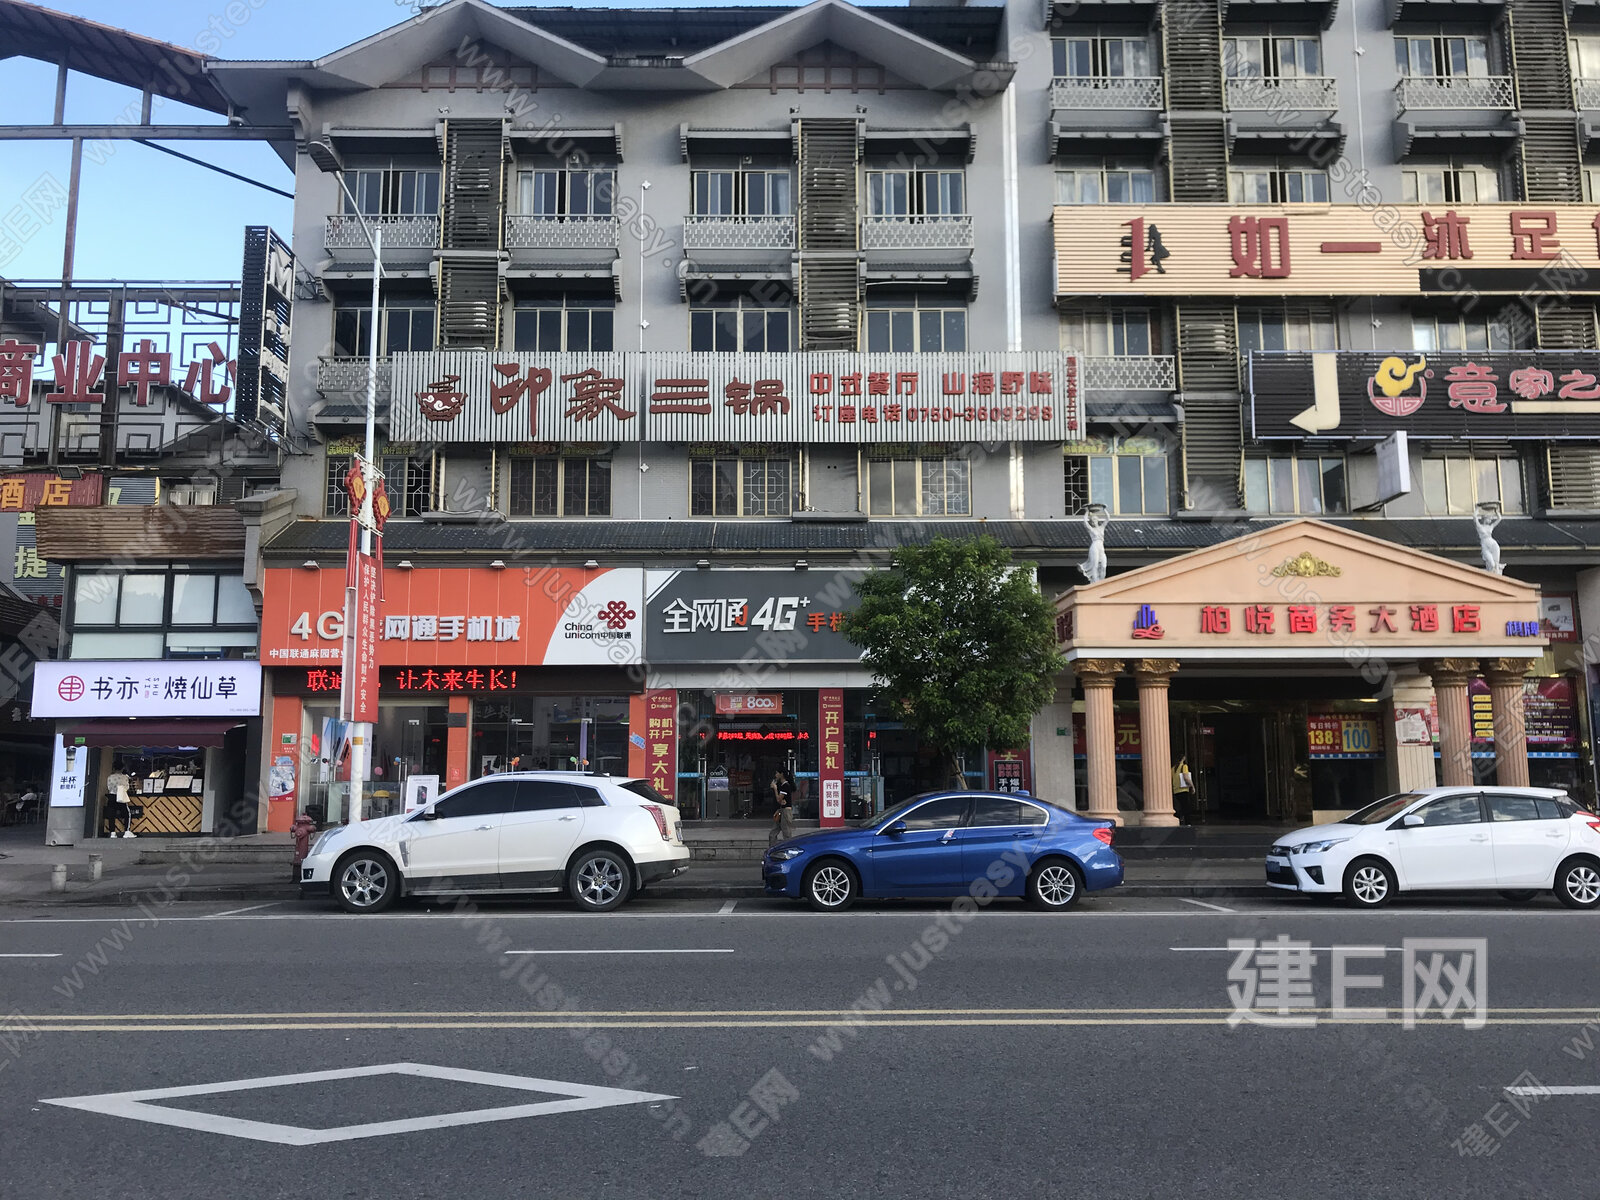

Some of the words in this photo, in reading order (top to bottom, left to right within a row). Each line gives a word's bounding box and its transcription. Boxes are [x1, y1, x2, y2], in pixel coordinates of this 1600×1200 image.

[1228, 210, 1600, 279] 如一沐足
[0, 338, 236, 408] 商业中心
[810, 372, 919, 395] 中式餐厅
[943, 371, 1052, 395] 山海野味
[490, 363, 790, 437] 印象三锅
[813, 403, 902, 424] 订座电话
[907, 405, 1053, 423] 0750-3609298
[565, 622, 593, 631] China
[661, 597, 748, 633] 全网通
[1200, 604, 1481, 634] 柏悦商务大酒店
[379, 615, 520, 642] 网通手机城
[564, 631, 600, 640] unicom
[600, 631, 632, 640] 中国联通
[1505, 621, 1539, 637] 棋牌
[90, 675, 140, 700] 书亦
[649, 718, 673, 728] 购机
[649, 729, 673, 739] 开户
[825, 711, 839, 769] 开户有礼
[1308, 730, 1334, 745] 138
[1343, 728, 1371, 749] 100
[652, 743, 669, 791] 享大礼
[60, 777, 77, 785] 半杯
